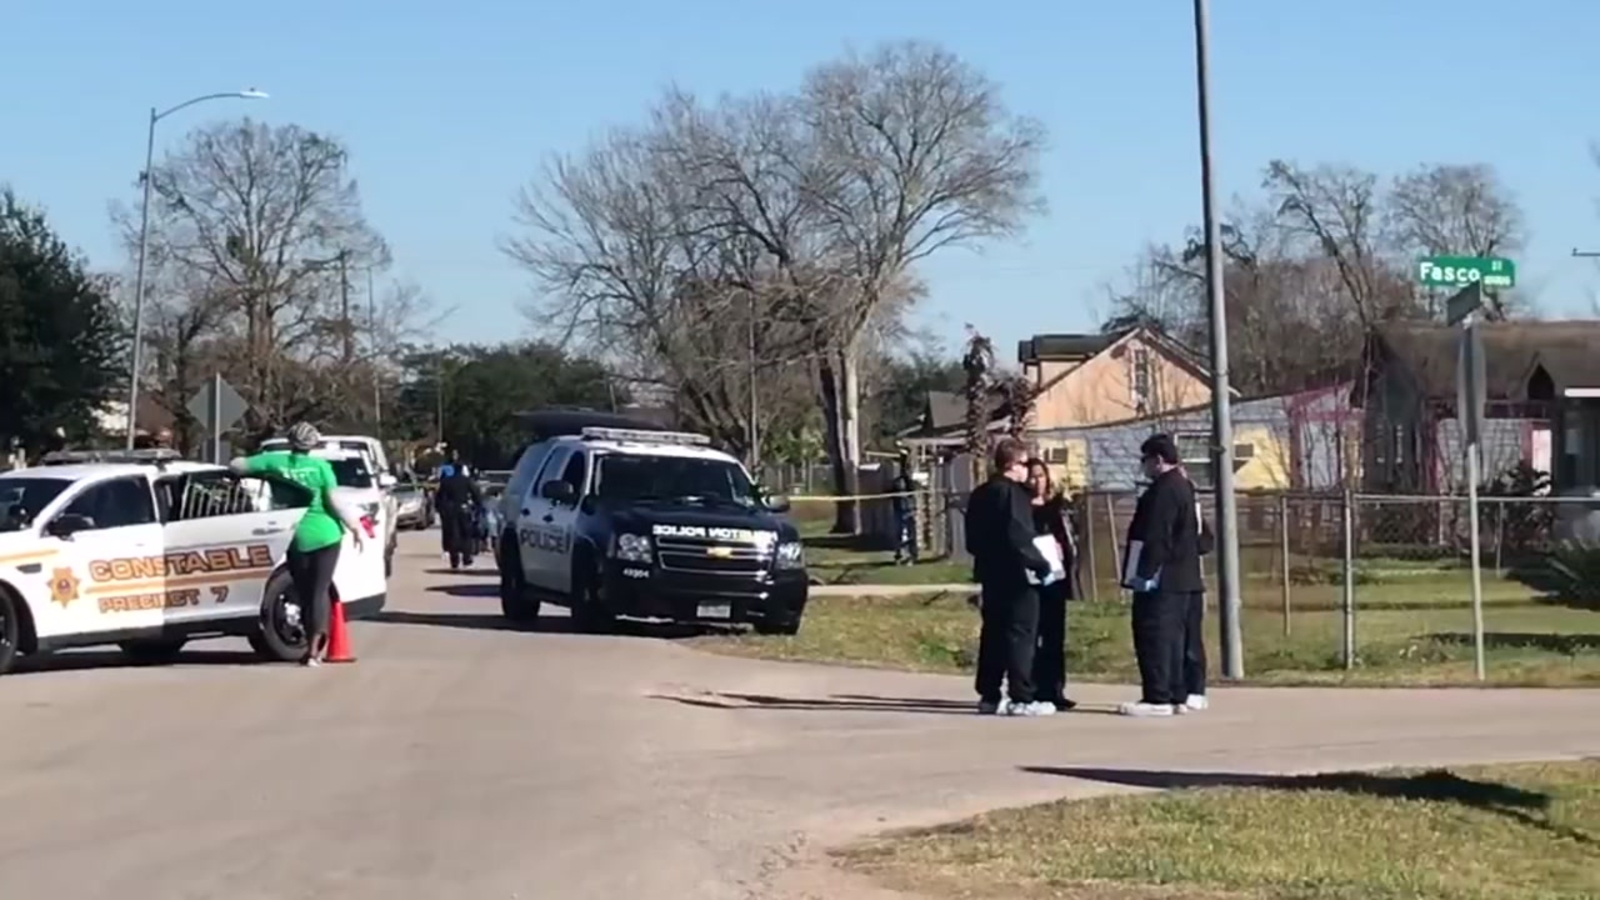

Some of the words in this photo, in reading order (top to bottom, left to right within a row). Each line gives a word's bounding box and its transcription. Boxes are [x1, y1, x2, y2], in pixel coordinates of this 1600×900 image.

[1420, 262, 1480, 282] Fasco
[520, 528, 565, 555] POLICE
[89, 545, 273, 581] CONSTABLE
[98, 587, 200, 613] PRECINCT
[211, 586, 228, 603] 7
